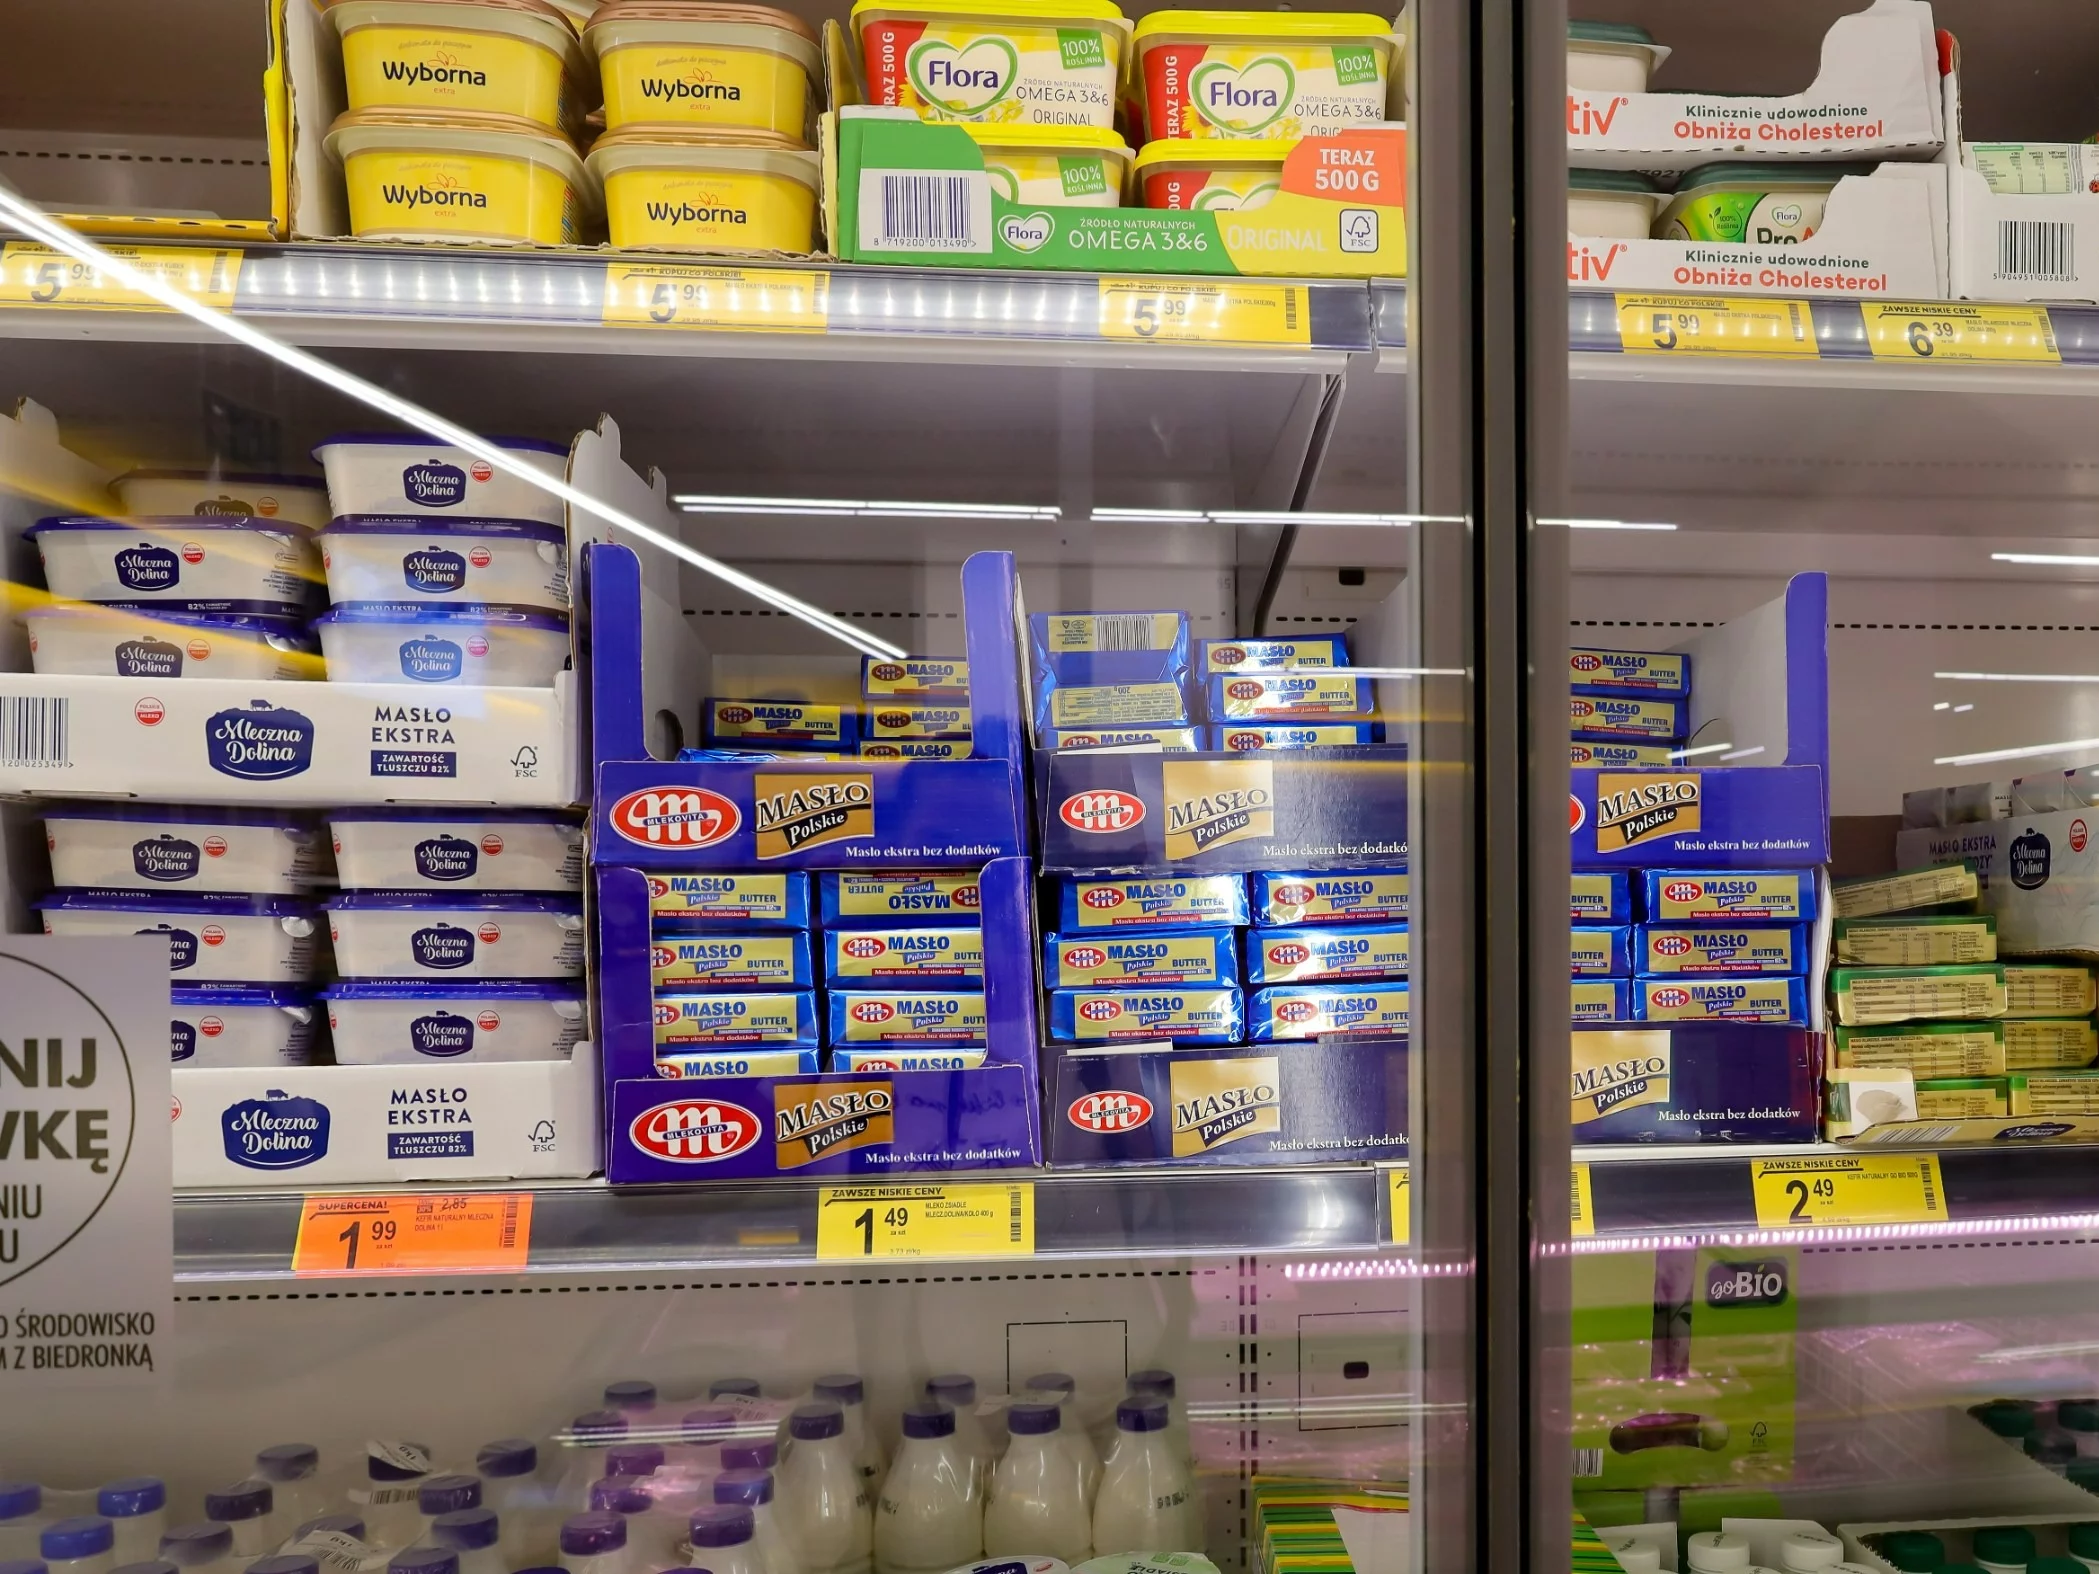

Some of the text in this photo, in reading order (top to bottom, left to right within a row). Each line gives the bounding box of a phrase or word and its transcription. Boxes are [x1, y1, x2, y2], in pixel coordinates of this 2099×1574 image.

[1061, 38, 1099, 57] 100%
[1337, 54, 1373, 73] 100%
[382, 60, 486, 87] Wyborna
[928, 59, 999, 89] Flora
[432, 85, 456, 96] extra
[641, 78, 740, 103] Wyborna
[1015, 85, 1109, 107] OMEGA 3&6
[1210, 80, 1277, 110] Flora
[1033, 109, 1094, 127] ORIGINAL
[1294, 102, 1381, 121] OMEGA 3&6
[1686, 103, 1868, 121] Klinicznie udowodnione
[1674, 120, 1884, 142] Obniża Cholesterol
[1320, 147, 1376, 167] TERAZ
[1062, 165, 1100, 184] 100%
[382, 183, 486, 209] Wyborna
[647, 201, 747, 226] Wyborna
[1776, 211, 1798, 221] Flora
[1079, 216, 1196, 232] ŹRÓDŁO NATURALNYCH
[1006, 224, 1043, 243] Flora
[1068, 228, 1208, 252] OMEGA 3&6
[1227, 225, 1328, 251] ORIGINAL
[1350, 239, 1371, 248] FSC
[1685, 250, 1870, 270] Klinicznie udowodnione
[31, 263, 63, 302] 5
[1674, 266, 1887, 292] Obniża Cholesterol
[649, 284, 677, 323] 5
[1164, 299, 1186, 316] 99
[1882, 304, 1977, 315] ZAWSZE NISKIE CENY
[1133, 298, 1159, 337] 5
[1678, 314, 1700, 330] 99
[1651, 312, 1678, 350] 5
[1906, 320, 1934, 357] 6
[1934, 321, 1954, 338] 39
[408, 469, 460, 484] Mleczna
[415, 483, 457, 497] Dolina
[121, 554, 173, 569] Mleczna
[408, 557, 460, 572] Mleczna
[127, 567, 170, 581] Dolina
[415, 569, 457, 584] Dolina
[375, 706, 452, 724] MASŁO
[753, 705, 803, 721] MASŁO
[215, 718, 303, 744] Mleczna
[804, 721, 834, 730] BUTTER
[371, 726, 456, 745] EKSTRA
[226, 739, 296, 764] Dolina
[381, 752, 445, 764] ZAWARTOŚĆ
[430, 765, 450, 774] 82%
[514, 769, 538, 779] FSC
[757, 783, 869, 828] MASŁO
[1169, 787, 1269, 832] MASŁO
[1599, 782, 1697, 825] MASŁO
[647, 811, 707, 826] MLEKOVITA
[1196, 812, 1247, 843] Polskie
[1625, 807, 1675, 840] Polskie
[790, 810, 845, 847] Polskie
[139, 844, 193, 861] Mleczna
[419, 844, 472, 860] Mleczna
[883, 842, 1002, 857] ekstra bez dodatków
[1300, 843, 1336, 856] ekstra
[1338, 843, 1359, 855] bez
[1707, 838, 1811, 851] ekstra bez dodatków
[1929, 836, 1997, 857] MASŁO EKSTRA
[145, 857, 189, 872] Dolina
[426, 857, 468, 872] Dolina
[2017, 859, 2044, 878] Dolina
[671, 877, 736, 893] MASŁO
[1125, 883, 1187, 899] MASŁO
[1703, 880, 1758, 895] MASŁO
[739, 894, 777, 903] BUTTER
[416, 933, 469, 948] Mleczna
[887, 936, 950, 951] MASŁO
[423, 946, 465, 961] Dolina
[678, 944, 743, 960] MASŁO
[1107, 943, 1168, 959] MASŁO
[746, 959, 785, 969] BUTTER
[682, 1000, 747, 1017] MASŁO
[1572, 1056, 1666, 1097] MASŁO
[390, 1087, 468, 1106] MASŁO
[1596, 1080, 1648, 1109] Polskie
[776, 1088, 892, 1141] MASŁO
[1176, 1082, 1275, 1131] MASŁO
[1692, 1109, 1726, 1121] ekstra
[1727, 1108, 1746, 1120] bez
[1747, 1107, 1801, 1120] dodatków
[231, 1107, 320, 1132] Mleczna
[388, 1107, 473, 1127] EKSTRA
[1203, 1109, 1254, 1141] Polskie
[398, 1133, 462, 1146] ZAWARTOŚĆ
[667, 1124, 726, 1142] MLEKOVITA
[810, 1116, 866, 1156] Polskie
[242, 1130, 313, 1156] Dolina
[447, 1144, 467, 1155] 82%
[532, 1143, 556, 1152] FSC
[1306, 1137, 1342, 1150] ekstra
[1343, 1135, 1364, 1149] bez
[903, 1147, 1021, 1163] ekstra bez dodatków
[1762, 1158, 1860, 1171] ZAWSZE NISKIE CENY
[831, 1186, 943, 1198] ZAWSZE NISKIE CENY
[1813, 1178, 1835, 1197] 49
[318, 1200, 388, 1211] SUPERCENA!
[440, 1197, 471, 1212] 2,85
[1785, 1180, 1813, 1225] 2
[432, 1212, 466, 1222] NATURALNY
[466, 1211, 494, 1221] MLECZNA
[884, 1207, 909, 1227] 49
[370, 1220, 397, 1241] 99
[854, 1207, 874, 1256] 1
[338, 1220, 361, 1270] 1
[1710, 1270, 1783, 1300] goBIO
[14, 1307, 155, 1340] ŚRODOWISKO
[13, 1342, 154, 1373] Z BIEDRONKĄ
